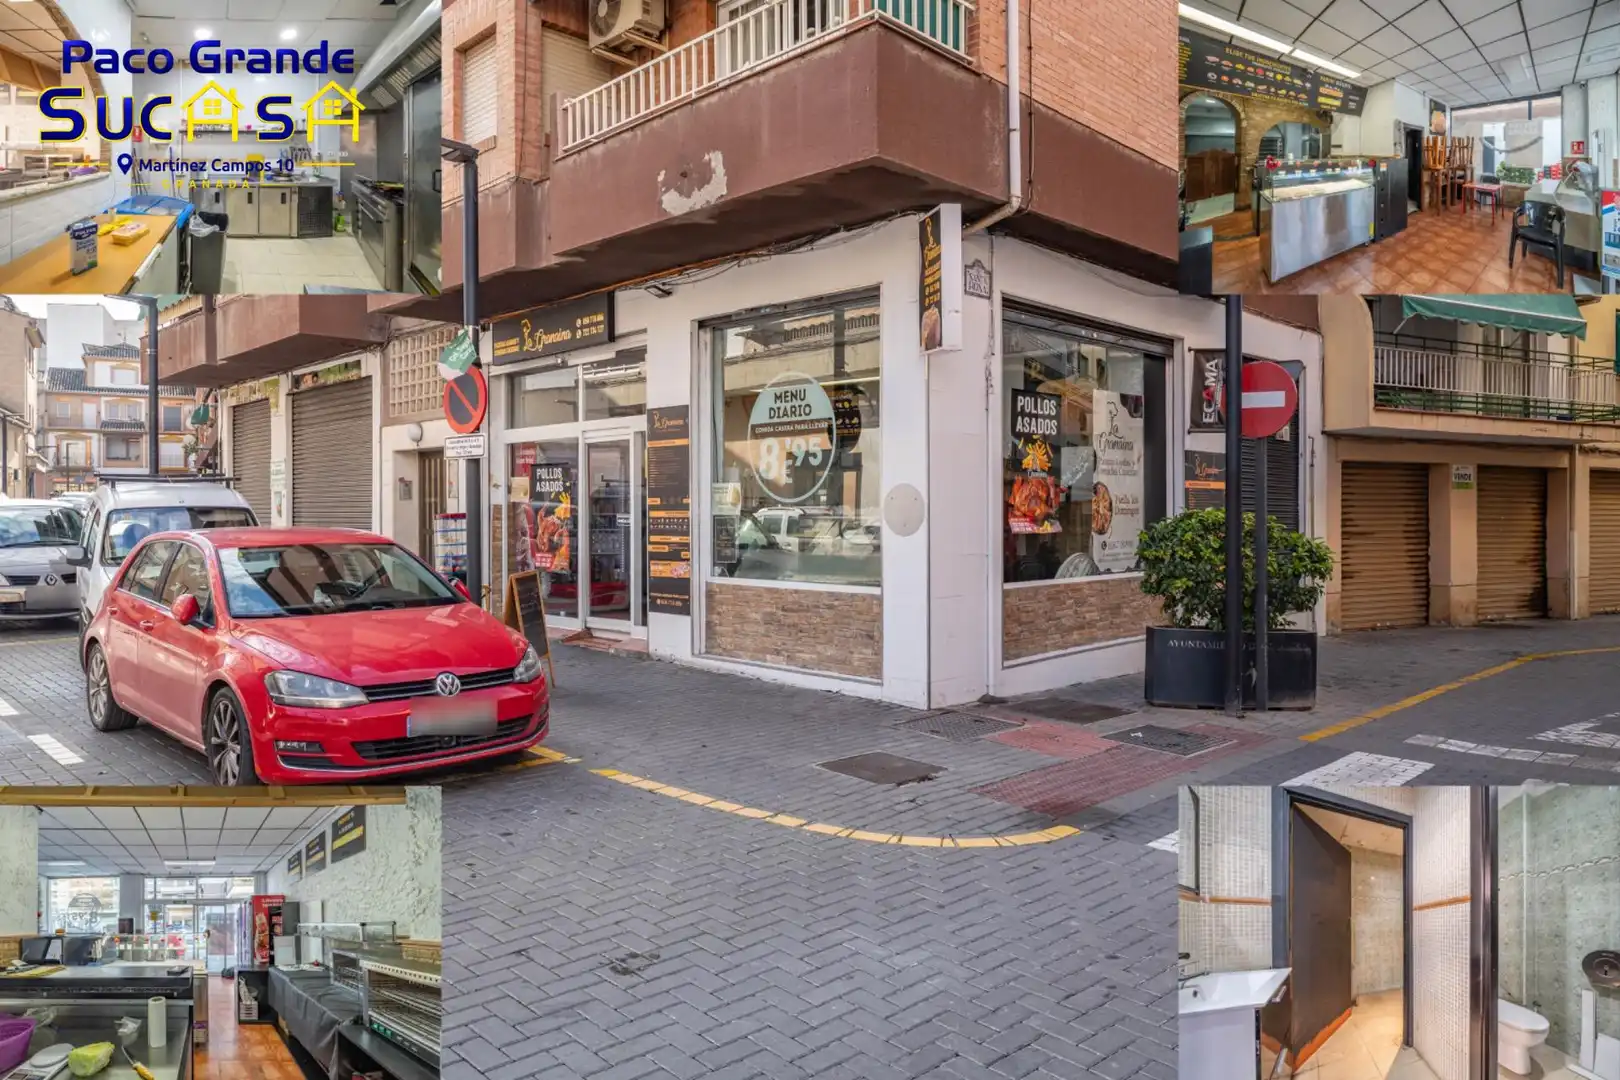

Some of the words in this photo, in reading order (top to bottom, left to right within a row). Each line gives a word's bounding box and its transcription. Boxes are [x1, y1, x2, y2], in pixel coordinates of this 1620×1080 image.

[774, 388, 807, 405] MENU
[768, 404, 812, 419] DIARIO
[1017, 396, 1057, 416] POLLOS
[1015, 416, 1058, 435] ASADOS
[536, 468, 563, 479] POLLOS
[1453, 472, 1472, 482] VENDE
[535, 480, 565, 493] ASADOS
[1167, 639, 1245, 651] AYUNTAMIE
